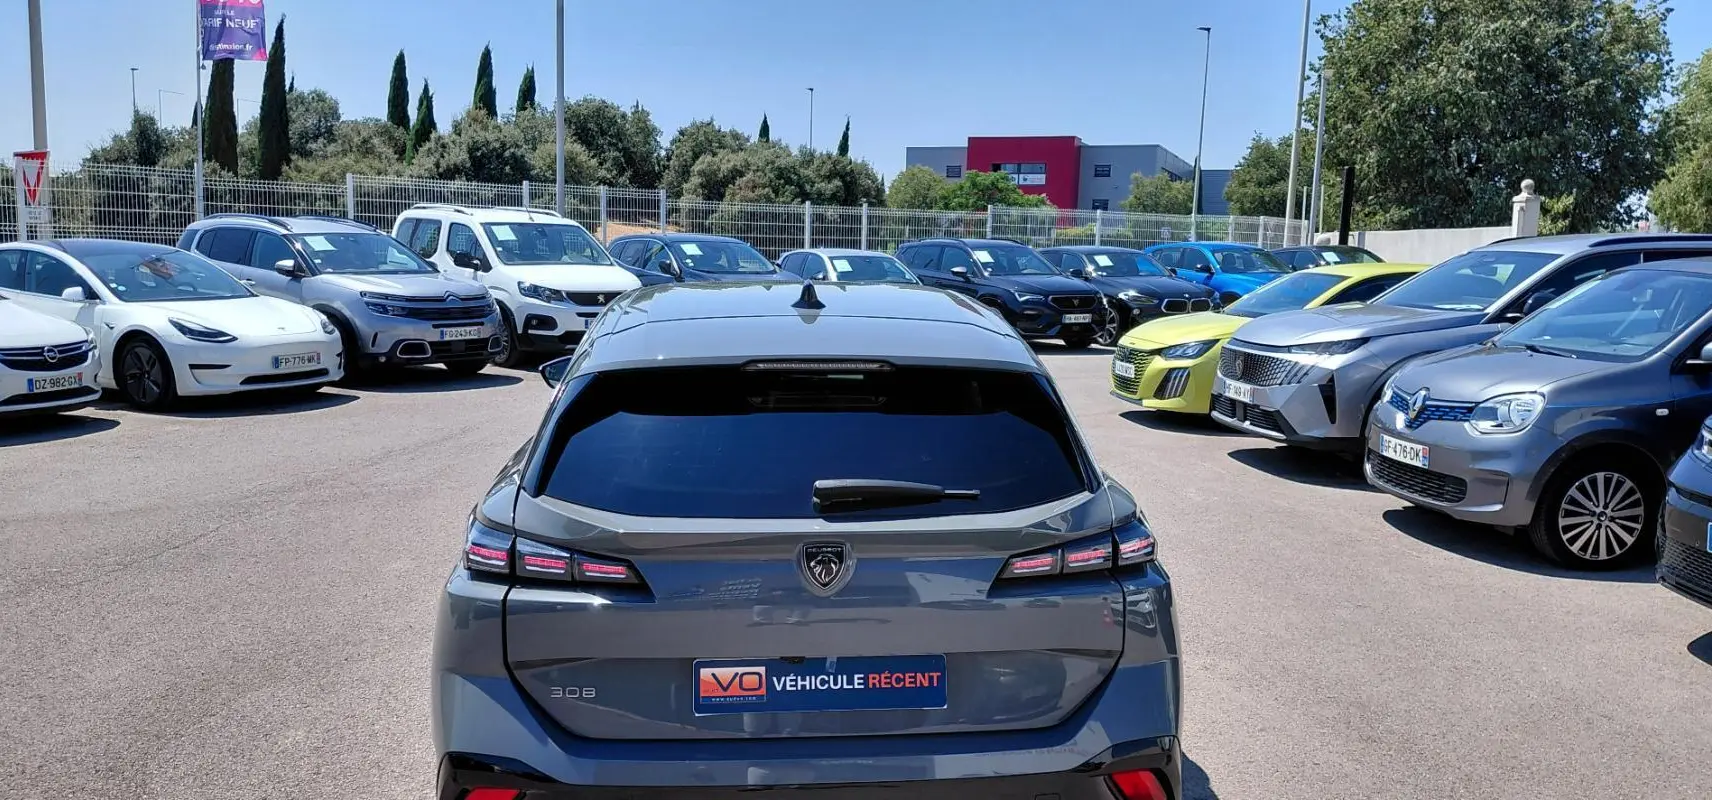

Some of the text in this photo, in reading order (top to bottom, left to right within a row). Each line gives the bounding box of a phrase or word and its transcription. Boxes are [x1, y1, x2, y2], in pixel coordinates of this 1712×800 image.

[34, 376, 79, 391] DZ-982-GX
[710, 670, 942, 692] VO VÉHICULE RÉCENT
[550, 686, 596, 698] 308
